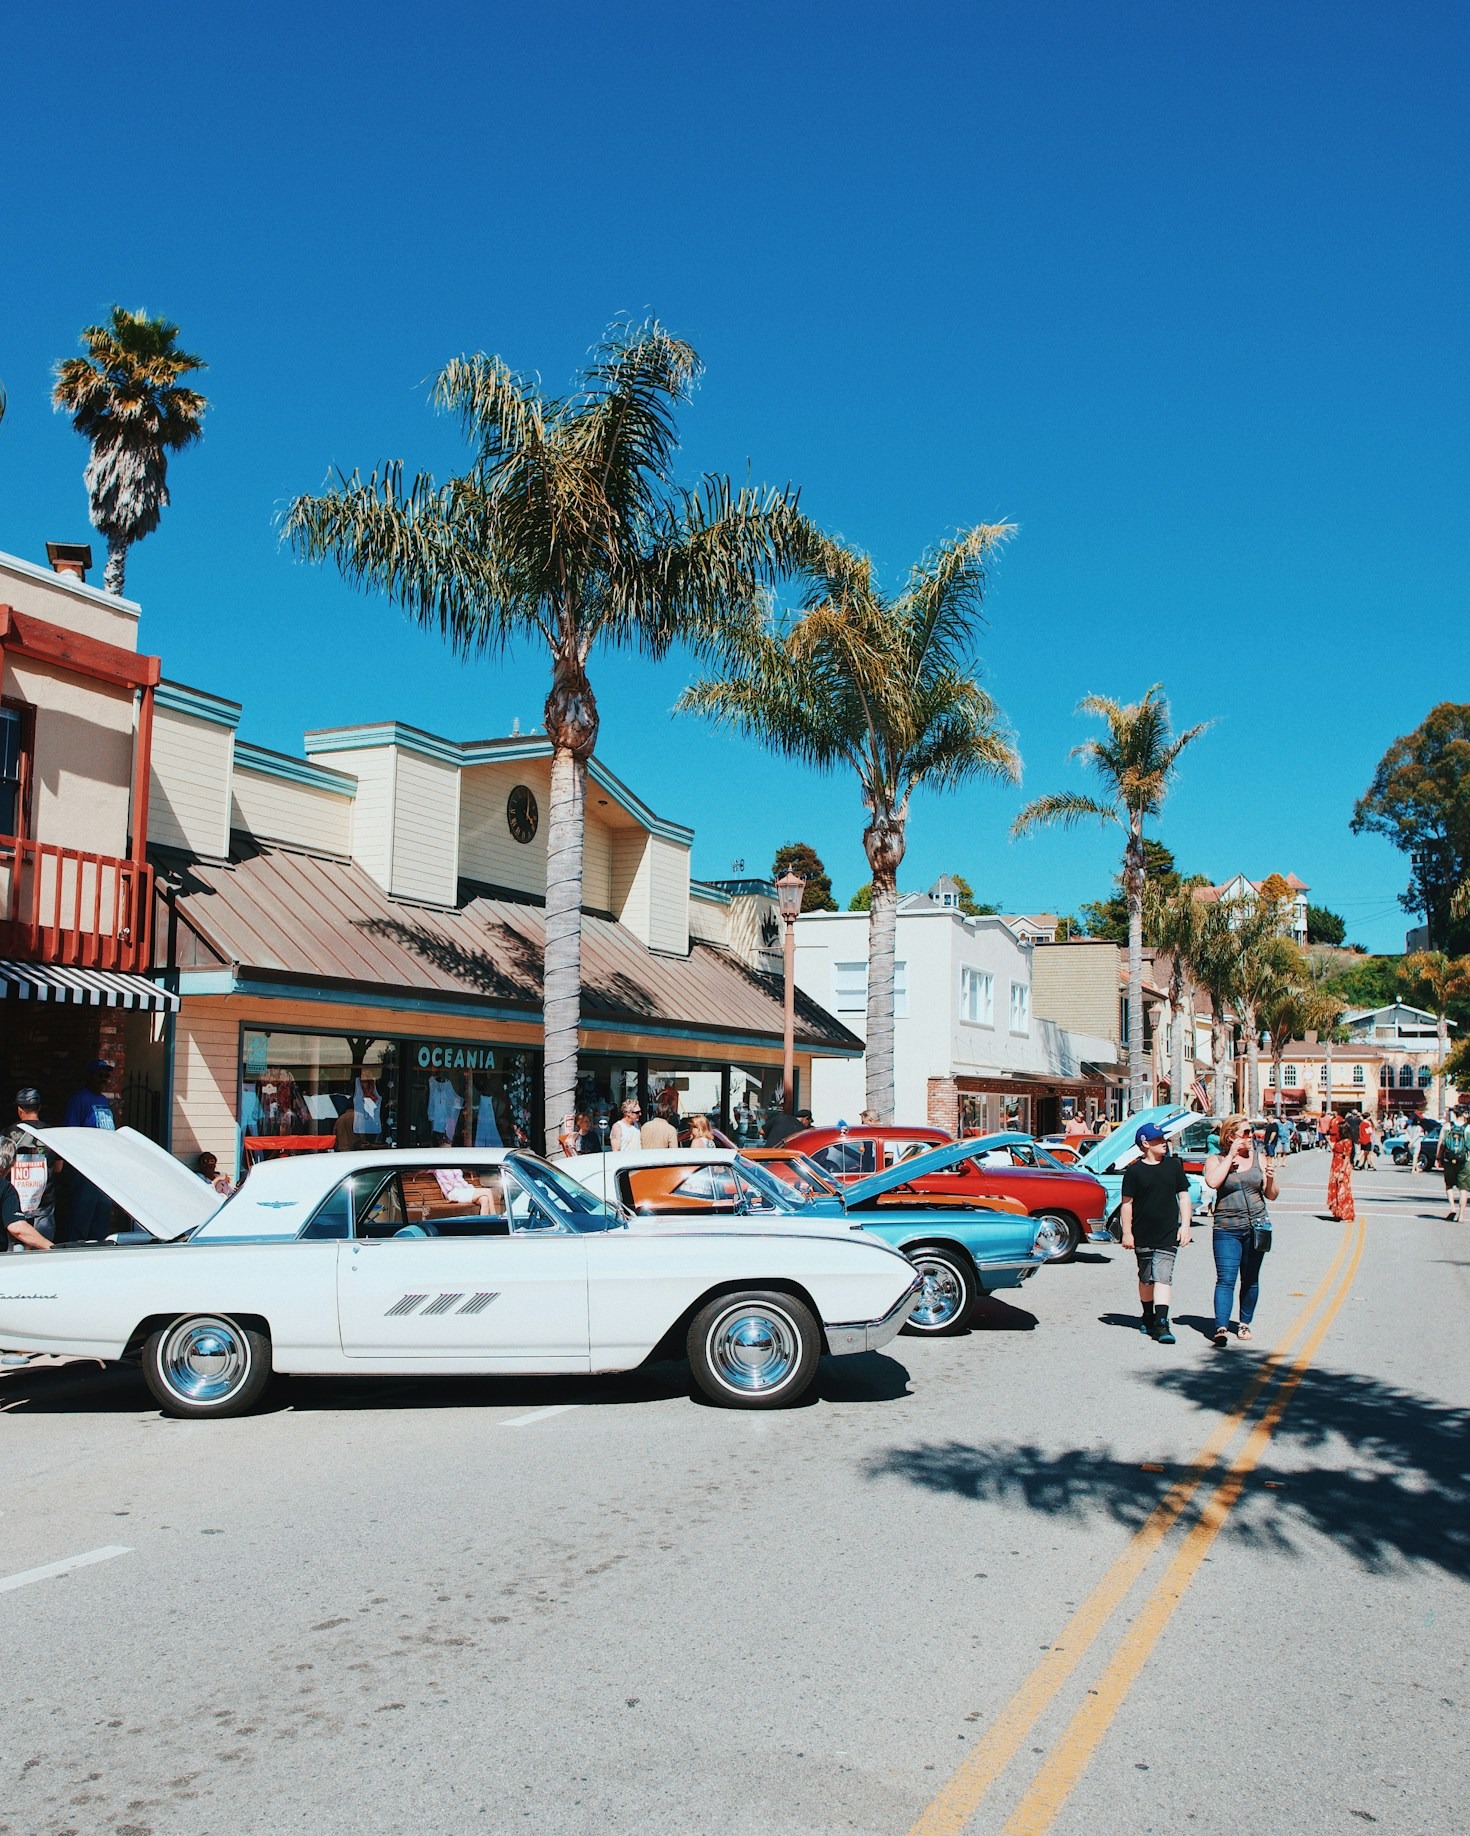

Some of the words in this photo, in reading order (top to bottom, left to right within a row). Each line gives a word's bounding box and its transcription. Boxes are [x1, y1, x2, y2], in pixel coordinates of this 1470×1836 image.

[418, 1046, 495, 1069] OCEANIA
[15, 1168, 29, 1180] NO
[17, 1180, 43, 1188] PARKING
